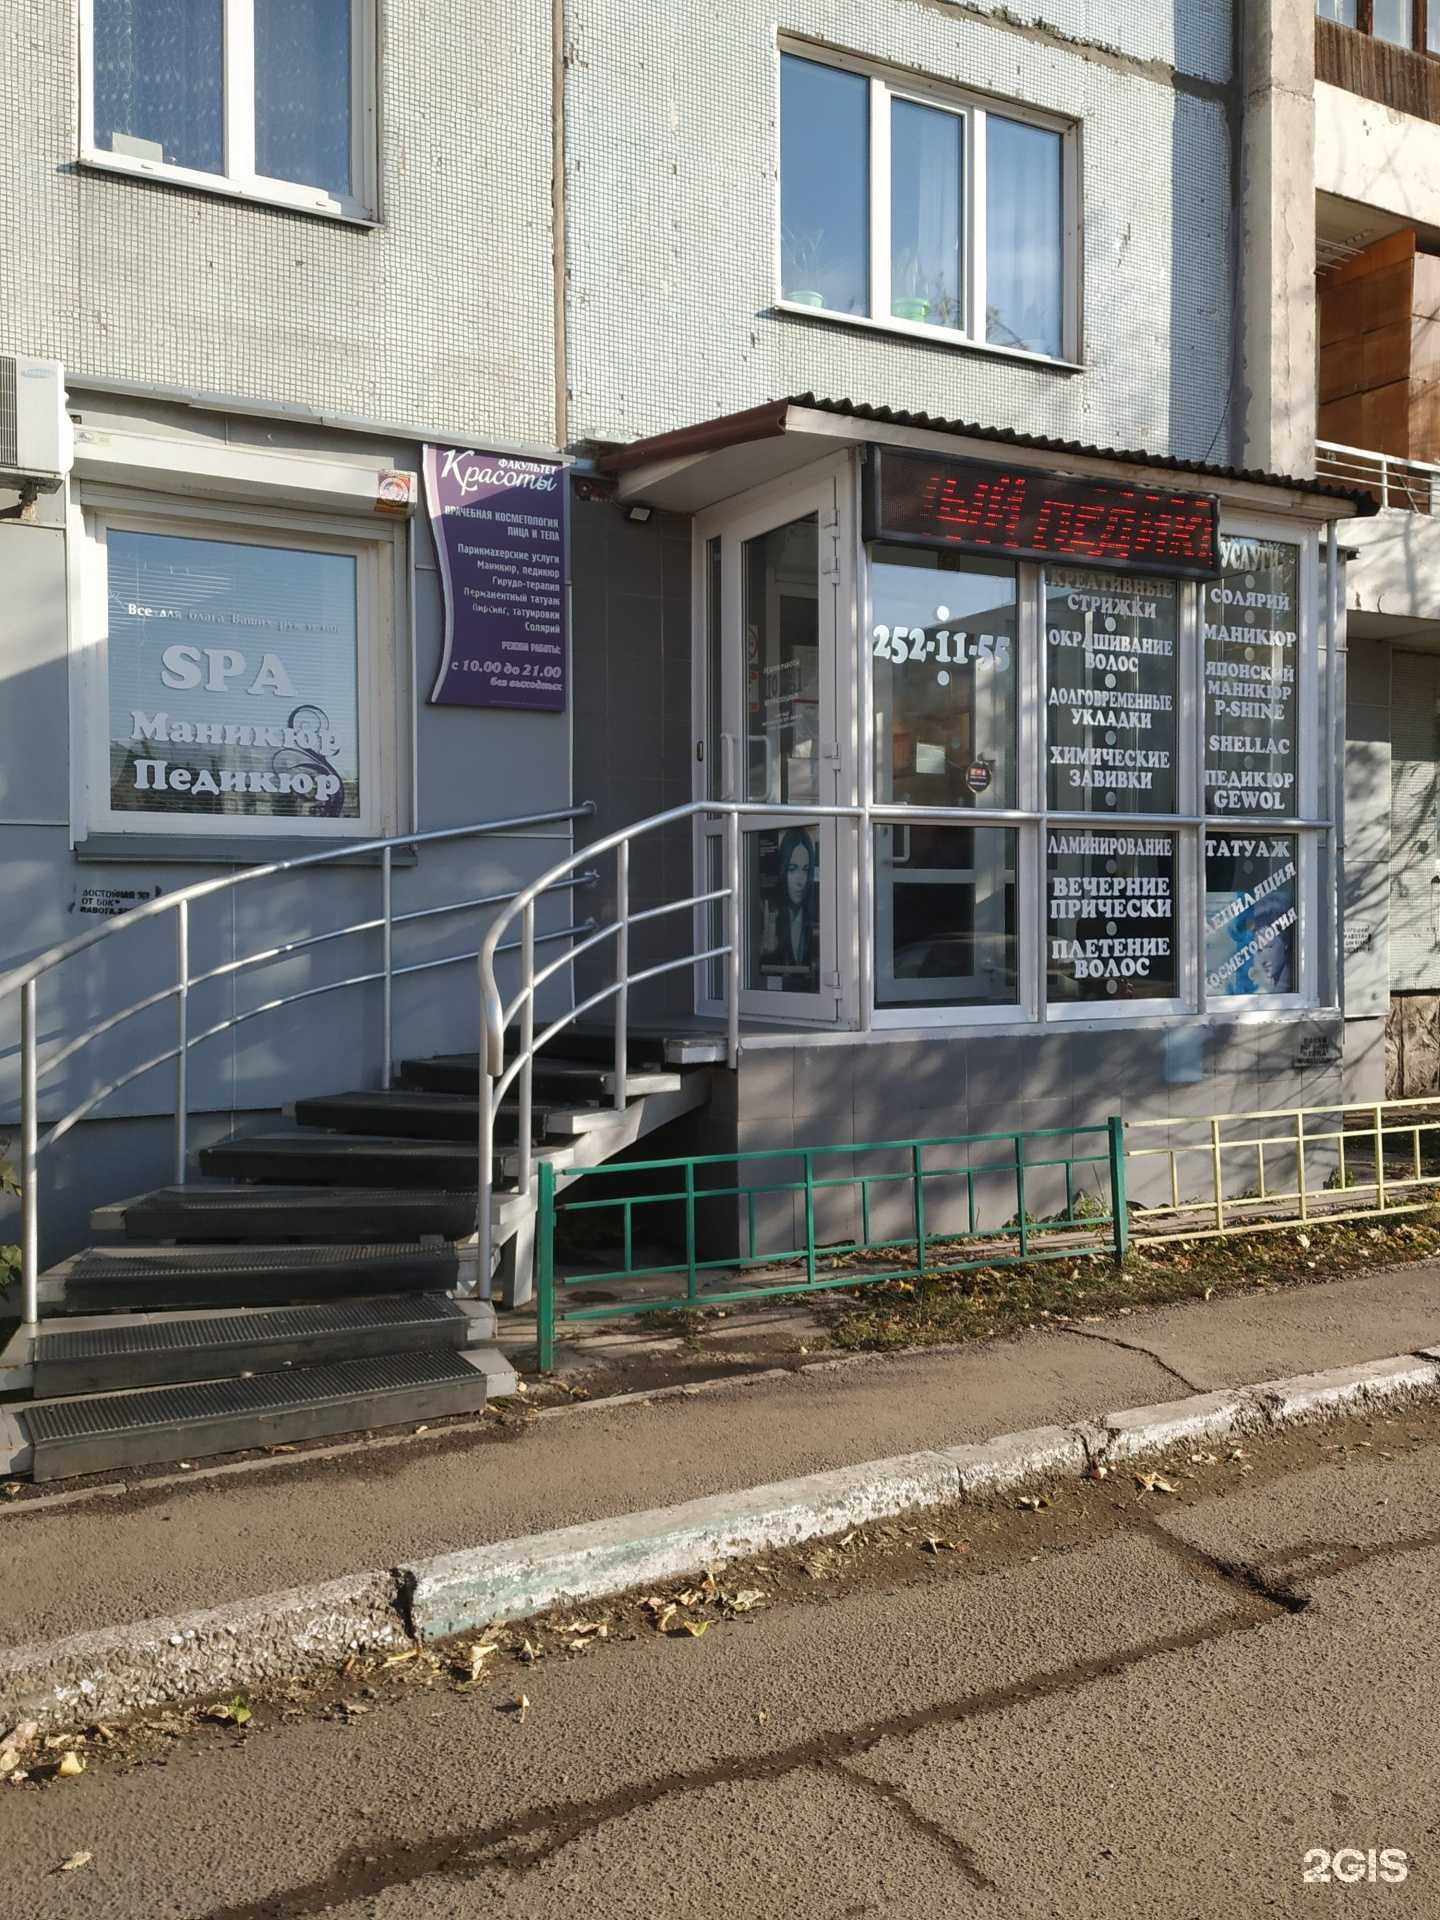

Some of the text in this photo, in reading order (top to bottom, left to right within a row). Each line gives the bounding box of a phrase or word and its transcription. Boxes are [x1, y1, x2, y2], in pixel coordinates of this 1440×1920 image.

[441, 449, 558, 496] Красоты
[498, 458, 558, 475] ФАКУЛЬТЕТ
[444, 505, 559, 528] ВРАЧЕБНАЯ КОСМЕТОЛОГИЯ
[507, 526, 560, 541] ЛИЦА И ТЕЛА
[457, 544, 560, 564] Парикмахерские услуги
[1220, 541, 1279, 573] УСЛУГИ
[477, 560, 560, 578] Маникюр, педикюр
[492, 576, 560, 592] Гирудо-терапия
[463, 587, 560, 606] Перманентный татуаж
[1067, 594, 1156, 619] СТРИЖКИ
[1210, 588, 1290, 610] СОЛЯРИЙ
[128, 603, 153, 617] Все
[472, 603, 560, 620] Пирсинг, татуировки
[524, 622, 560, 634] Солярий
[1202, 623, 1296, 647] МАНИКЮР
[873, 624, 1010, 673] 252-11-55
[1048, 628, 1173, 656] ОКРАШИВАНИЕ
[161, 645, 297, 697] SPA
[451, 660, 561, 678] с 10.00 до 21.00
[1085, 651, 1139, 672] ВОЛОС
[1205, 661, 1294, 682] ЯПОНСКИЙ
[1048, 687, 1173, 711] ДОЛГОВРЕМЕННЫЕ
[1208, 680, 1292, 700] МАНИКЮР
[1071, 708, 1152, 729] УКЛАДКИ
[1214, 700, 1285, 720] P-SHINE
[130, 711, 341, 757] Маникюр
[1209, 735, 1290, 754] SHELLAC
[1050, 746, 1170, 768] ХИМИЧЕСКИЕ
[133, 759, 341, 801] Педикюр
[1069, 769, 1153, 789] ЗАВИВКИ
[1204, 770, 1294, 789] ПЕДИКЮР
[1214, 790, 1285, 810] GEWOL
[1048, 836, 1173, 856] ЛАМИНИРОВАНИЕ
[1205, 840, 1290, 857] ТАТУАЖ
[1053, 877, 1170, 896] ВЕЧЕРНИЕ
[1050, 899, 1172, 919] ПРИЧЕСКИ
[1052, 938, 1171, 959] ПЛЕТЕНИЕ
[1074, 958, 1150, 979] ВОЛОС
